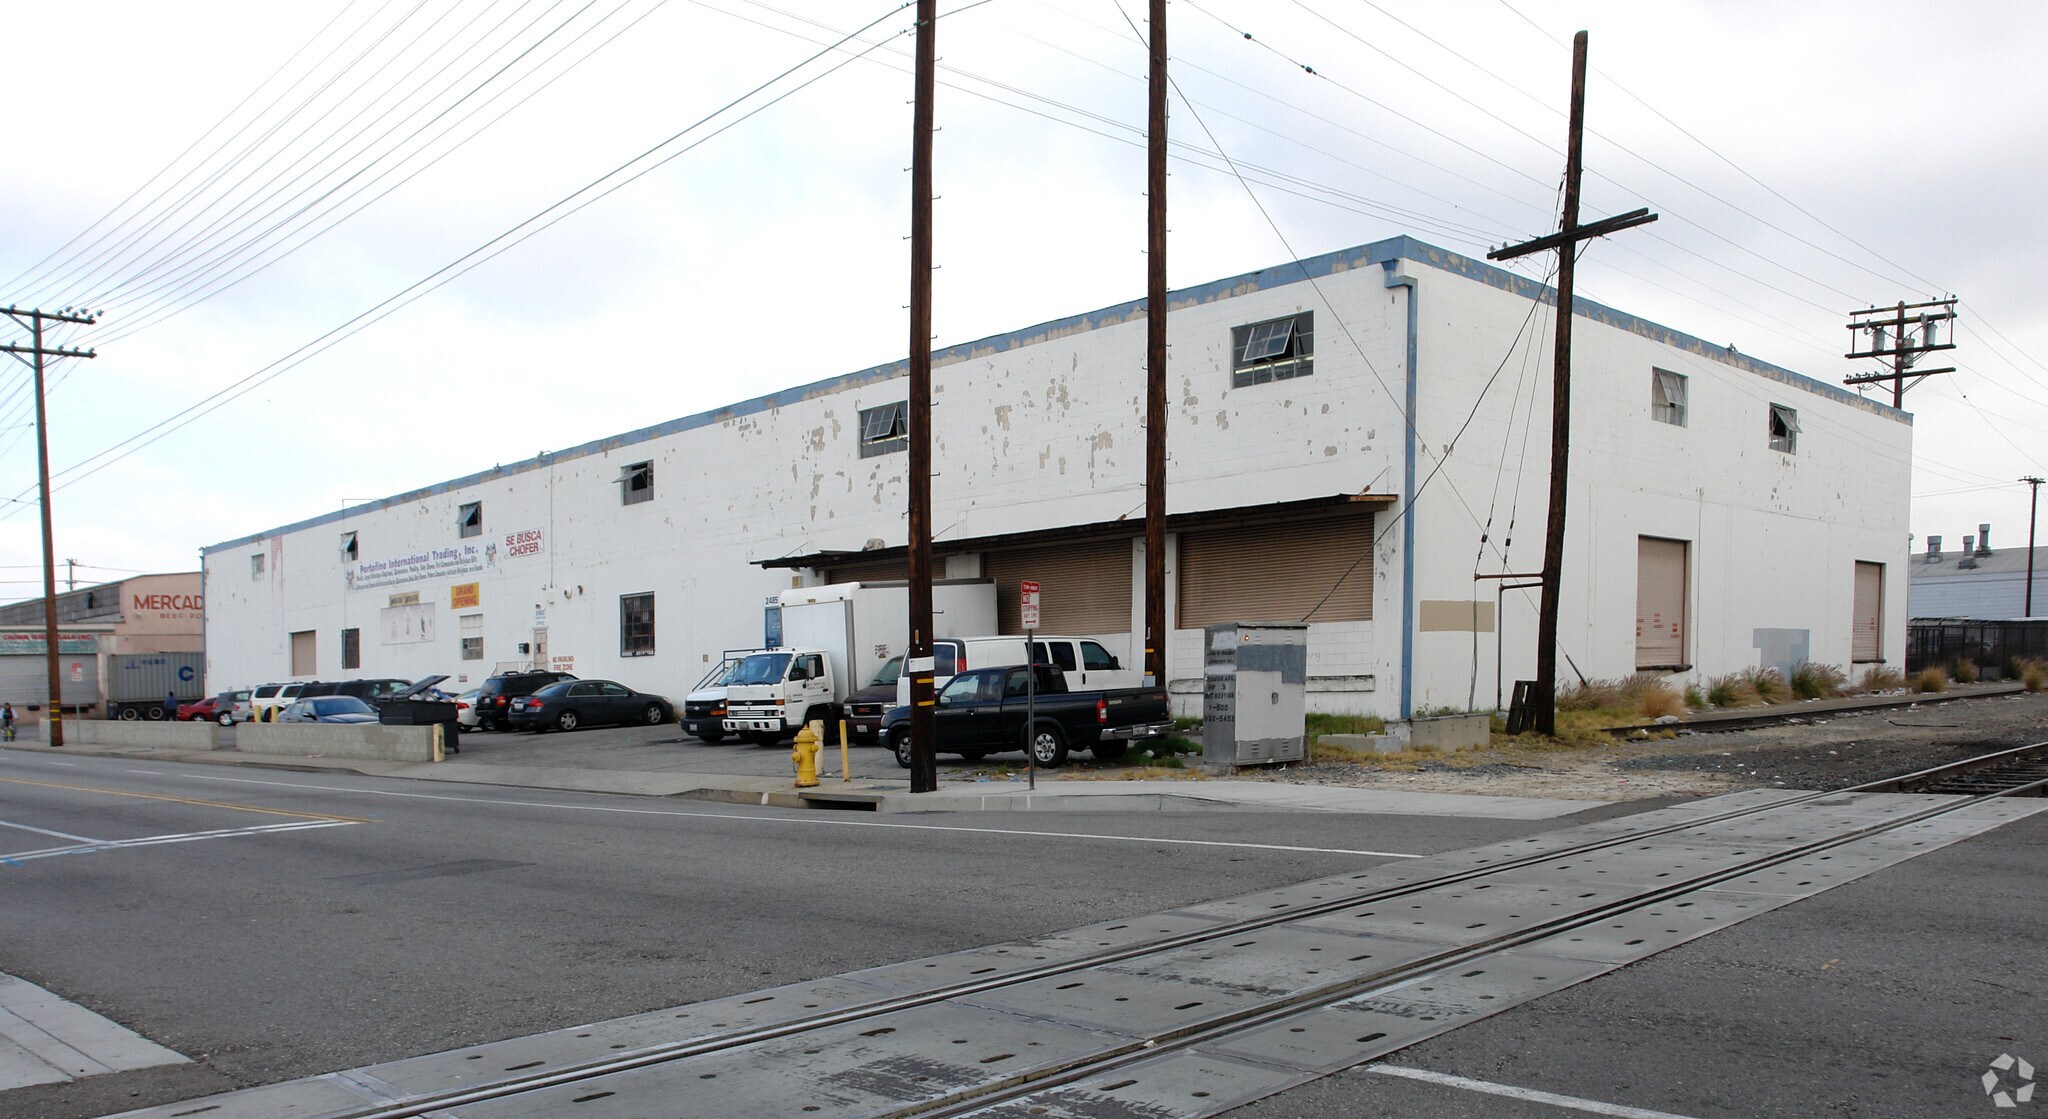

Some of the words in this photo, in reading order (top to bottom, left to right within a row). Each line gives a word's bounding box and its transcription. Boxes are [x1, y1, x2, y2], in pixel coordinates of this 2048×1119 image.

[506, 535, 515, 546] SE
[516, 530, 542, 544] BUSCA
[509, 542, 539, 557] CHOFER
[360, 561, 387, 574] Portofino
[388, 552, 429, 569] International
[464, 545, 479, 555] Inc.
[456, 584, 474, 596] GRAND
[133, 594, 203, 610] MERCAD
[453, 594, 477, 608] OPENING
[765, 596, 779, 605] 2485
